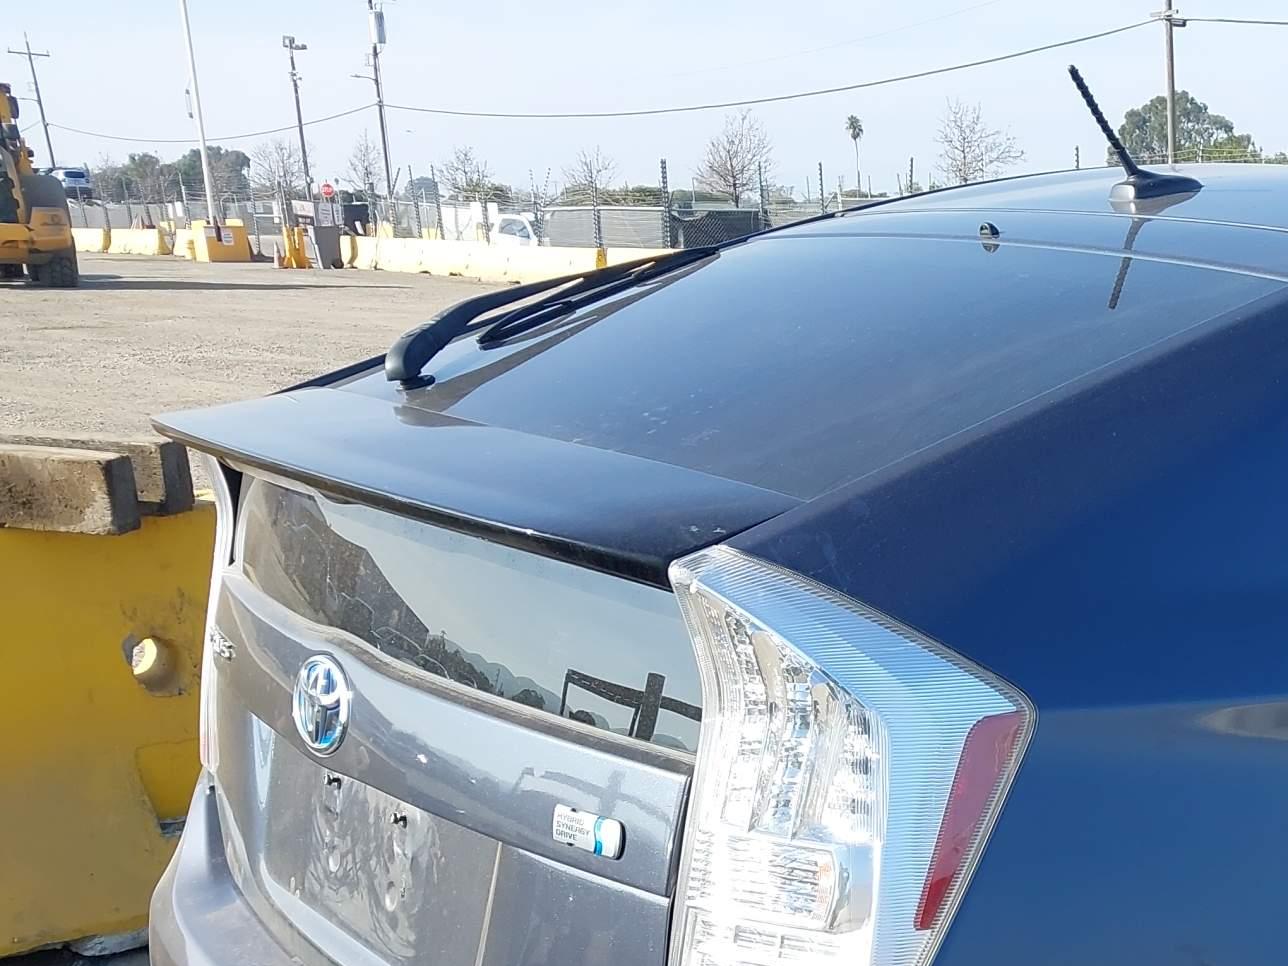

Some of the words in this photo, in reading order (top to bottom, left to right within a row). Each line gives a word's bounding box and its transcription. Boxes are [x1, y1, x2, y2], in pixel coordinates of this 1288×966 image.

[557, 811, 585, 826] HYBRID
[555, 828, 577, 841] DRIVE
[556, 820, 590, 836] SYNERGY
